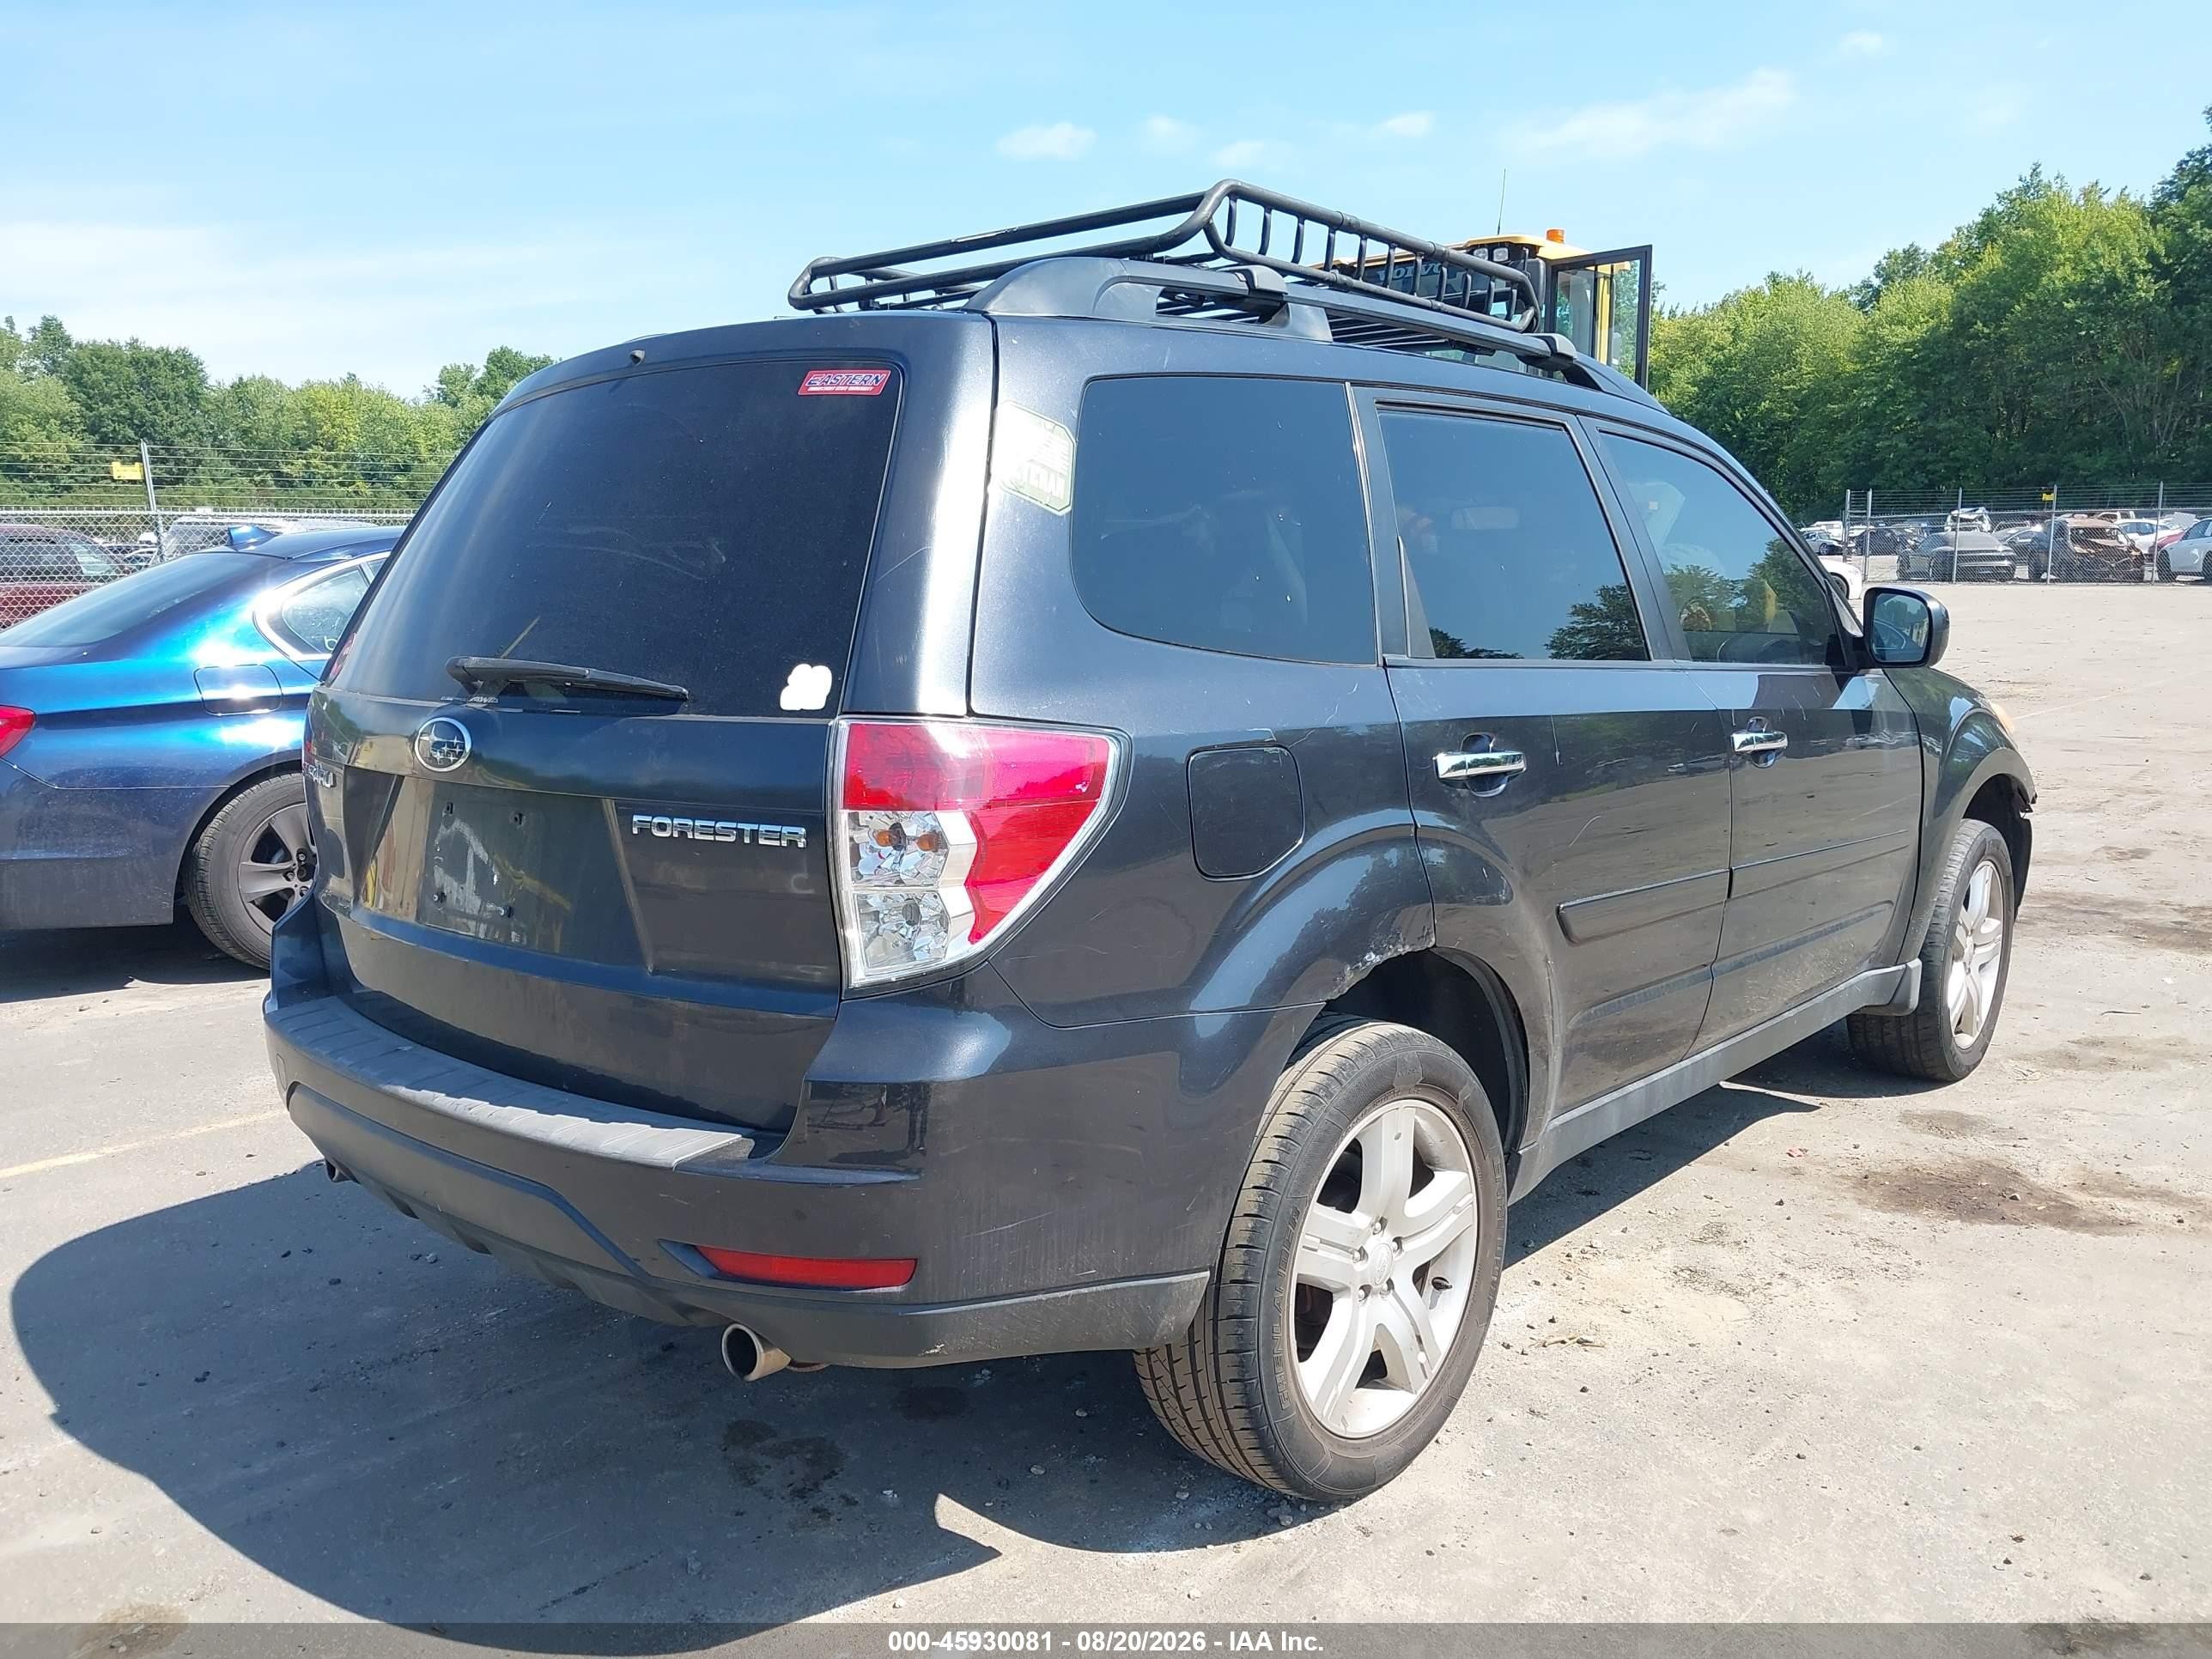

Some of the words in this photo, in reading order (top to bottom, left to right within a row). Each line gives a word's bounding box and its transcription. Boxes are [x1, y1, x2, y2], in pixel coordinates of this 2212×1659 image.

[1376, 262, 1442, 282] VOLVO
[805, 374, 887, 386] EASTERN
[632, 814, 807, 848] FORESTER
